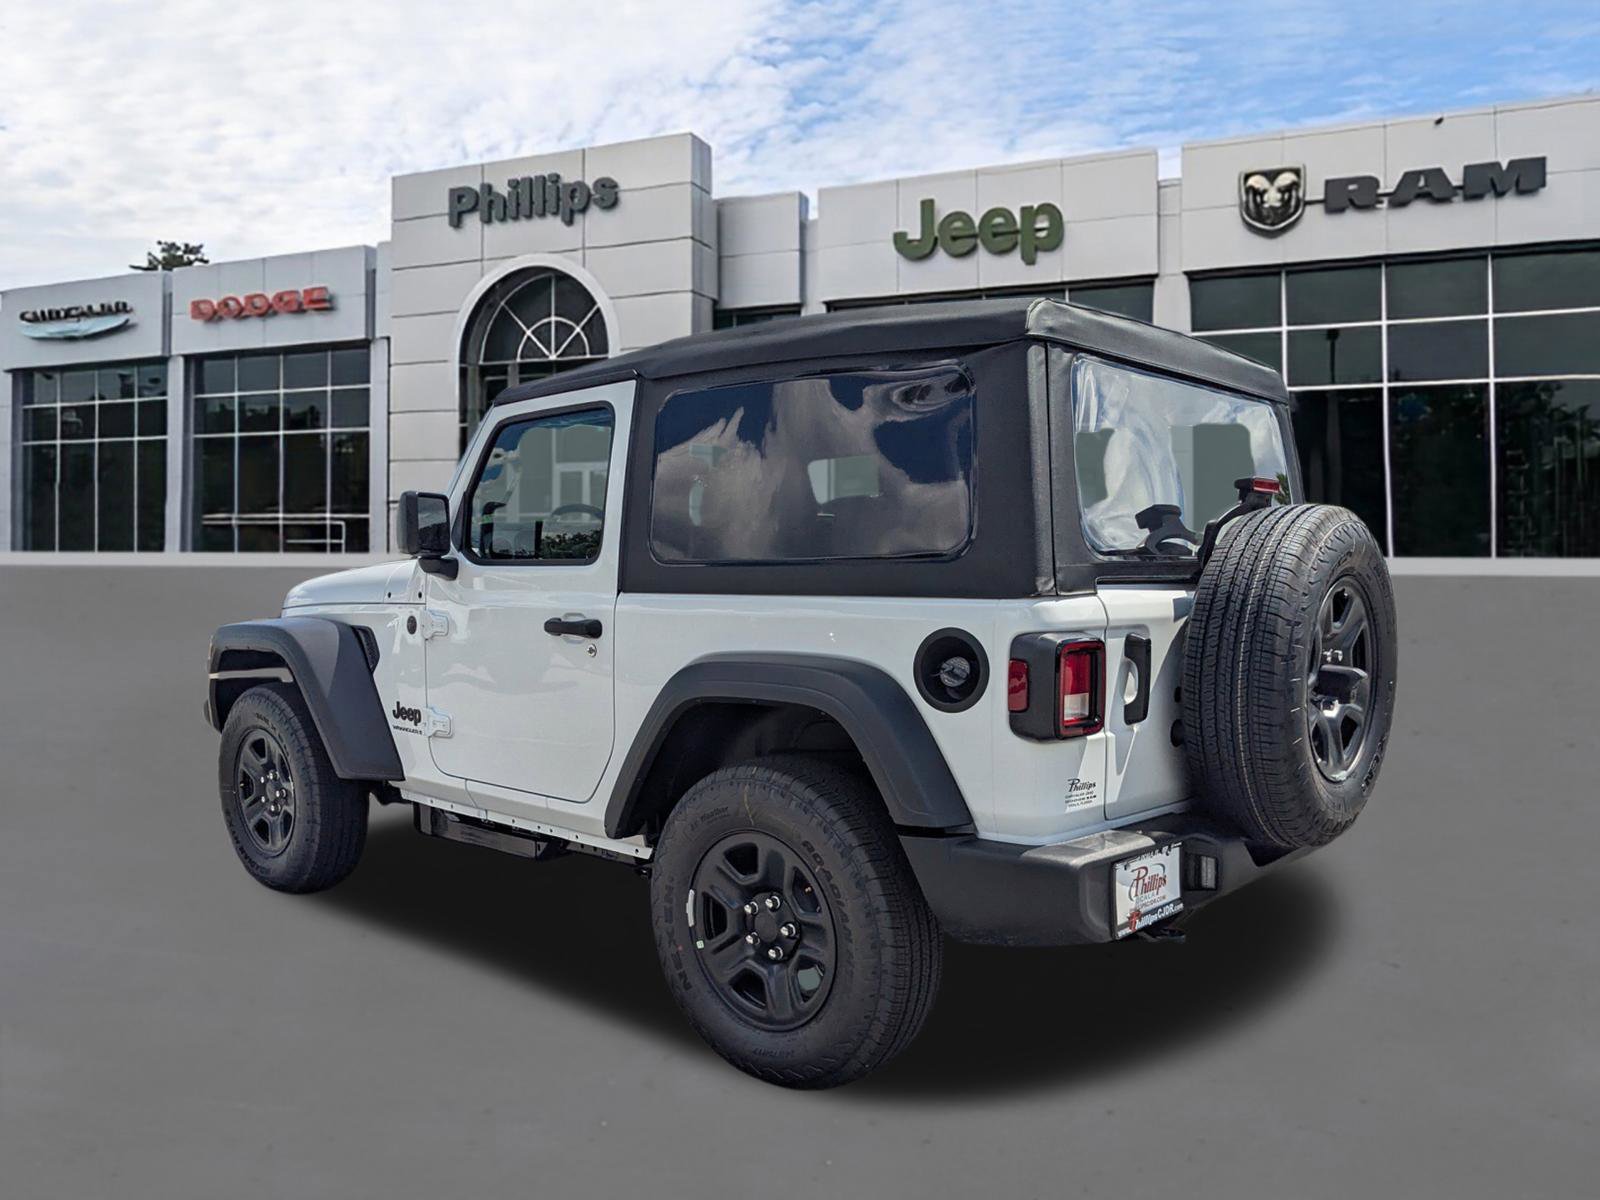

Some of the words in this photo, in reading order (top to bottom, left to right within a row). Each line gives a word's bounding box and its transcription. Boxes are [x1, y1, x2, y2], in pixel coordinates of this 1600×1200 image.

[448, 173, 619, 229] Phillips
[1325, 157, 1547, 213] RAM
[893, 198, 1065, 266] Jeep
[190, 286, 332, 320] DODGE
[392, 700, 422, 727] Jeep
[1130, 865, 1167, 898] Phillips
